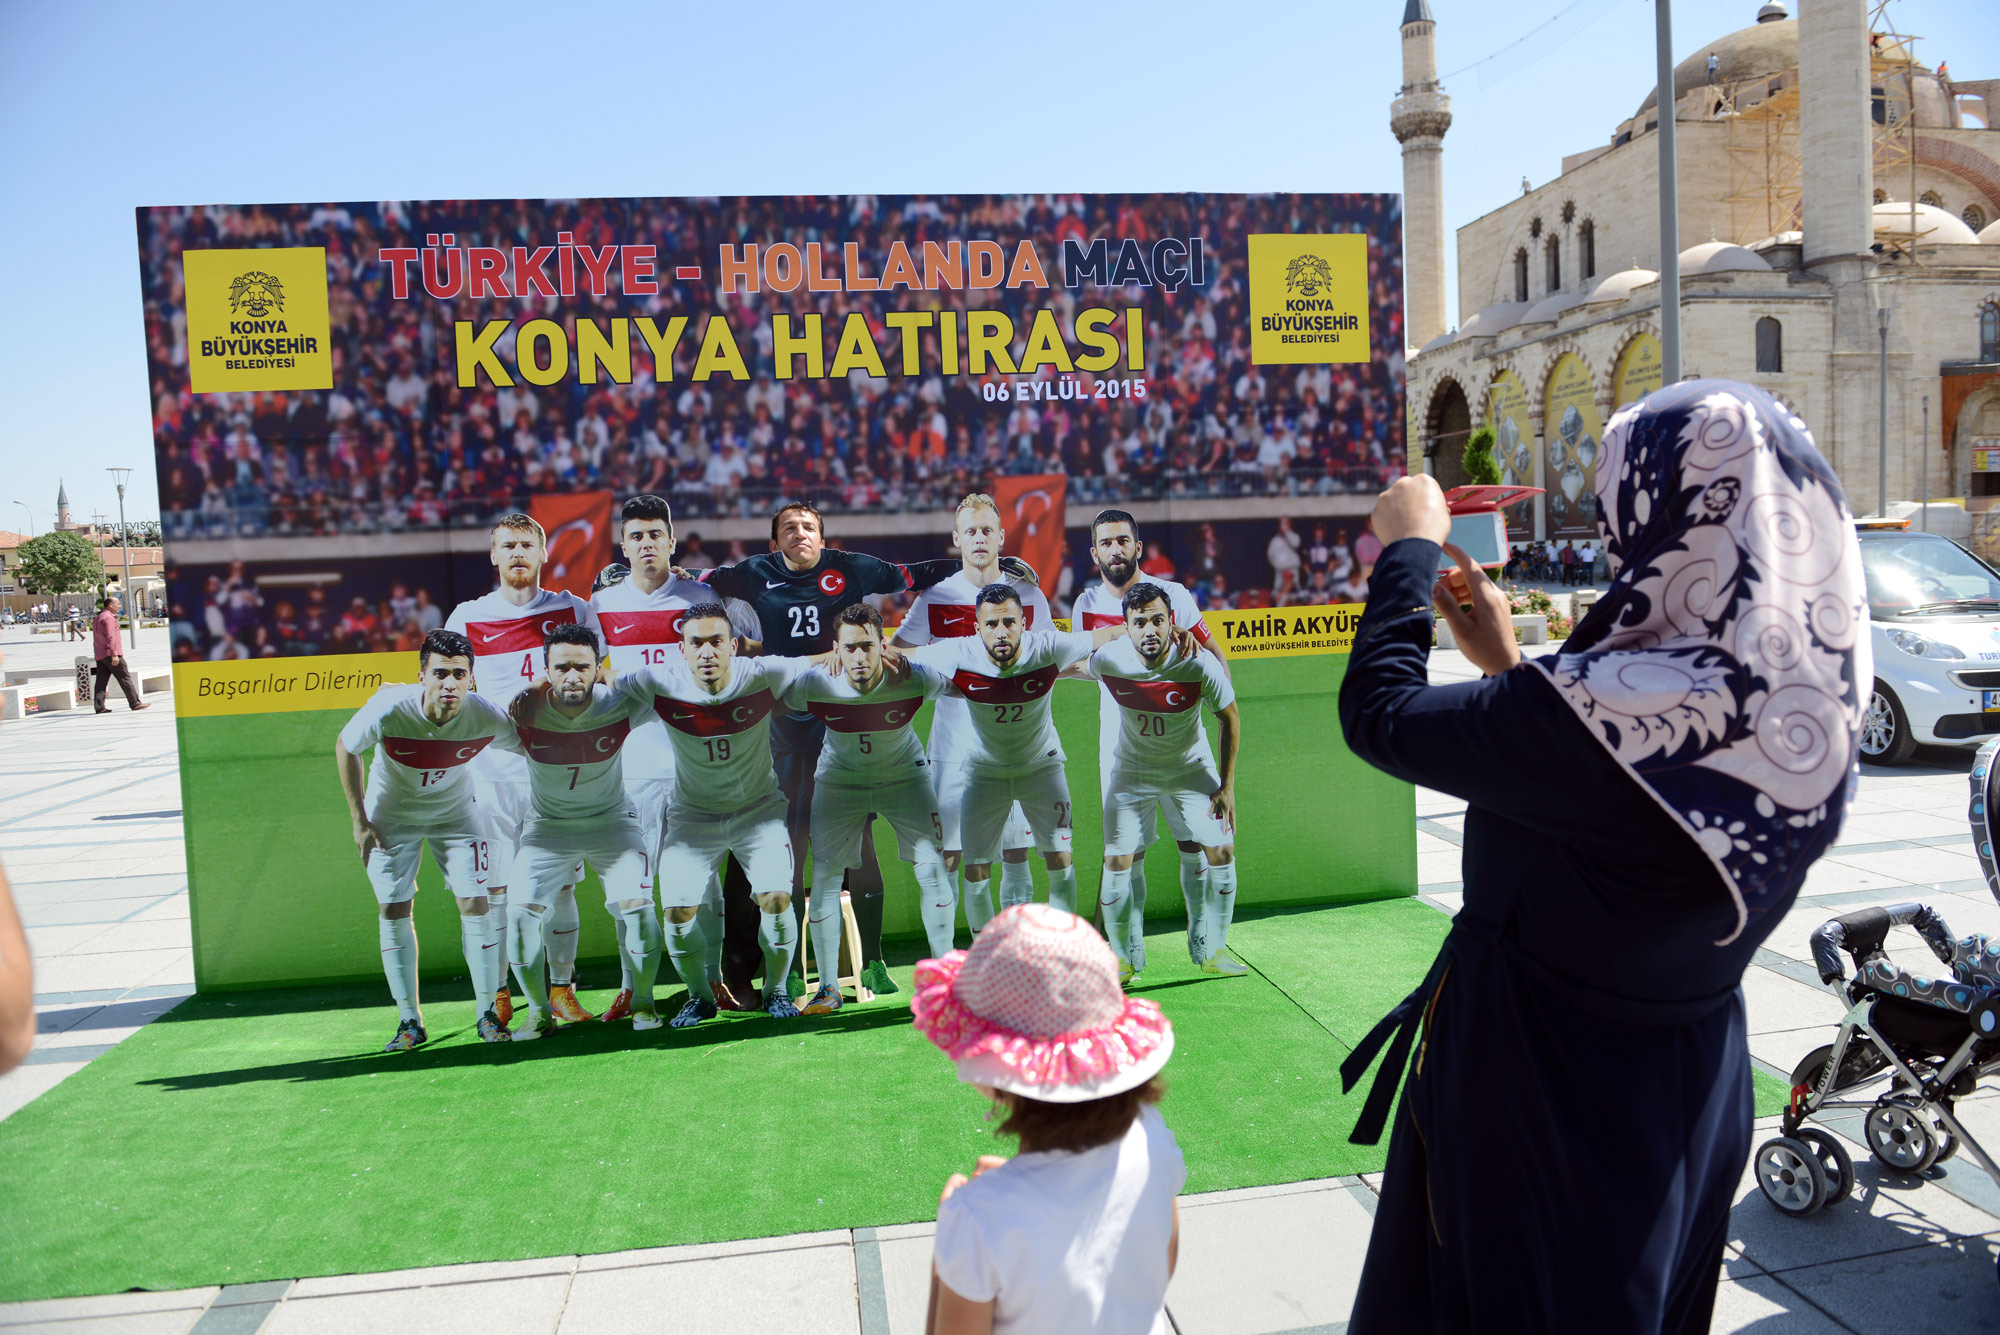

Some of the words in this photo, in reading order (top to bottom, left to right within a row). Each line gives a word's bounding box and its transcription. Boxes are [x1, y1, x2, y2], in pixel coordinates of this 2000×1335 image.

[378, 231, 659, 299] TÜRKİYE
[719, 240, 1049, 293] HOLLANDA
[1064, 238, 1205, 293] MAÇI
[1286, 299, 1334, 312] KONYA
[230, 320, 288, 334] KONYA
[1261, 312, 1359, 333] BÜYÜKŞEHİR
[201, 334, 318, 357] BÜYÜKŞEHİR
[454, 315, 752, 389] KONYA
[772, 306, 1146, 380] HATIRASI
[1281, 331, 1340, 343] BELEDİYESİ
[225, 356, 296, 370] BELEDİYESİ
[983, 382, 1010, 402] 06
[1015, 375, 1088, 401] EYLÜL
[1094, 379, 1146, 399] 2015
[788, 605, 820, 638] 23
[1222, 614, 1287, 639] TAHİR
[1292, 610, 1363, 636] AKYÜR
[1230, 643, 1258, 653] KONYA
[1259, 639, 1310, 651] BÜYÜKŞEHİR
[1311, 637, 1349, 649] BELEDİYE
[1978, 651, 2000, 661] TUR
[520, 653, 534, 683] 4
[198, 673, 297, 700] Başarılar
[305, 669, 382, 691] Dilerim
[993, 705, 1024, 723] 22
[1137, 714, 1166, 736] 20
[703, 738, 731, 762] 19
[858, 733, 872, 755] 5
[567, 766, 580, 791] 7
[930, 812, 943, 841] 5
[469, 841, 489, 872] 13
[1816, 1055, 1836, 1095] POWER
